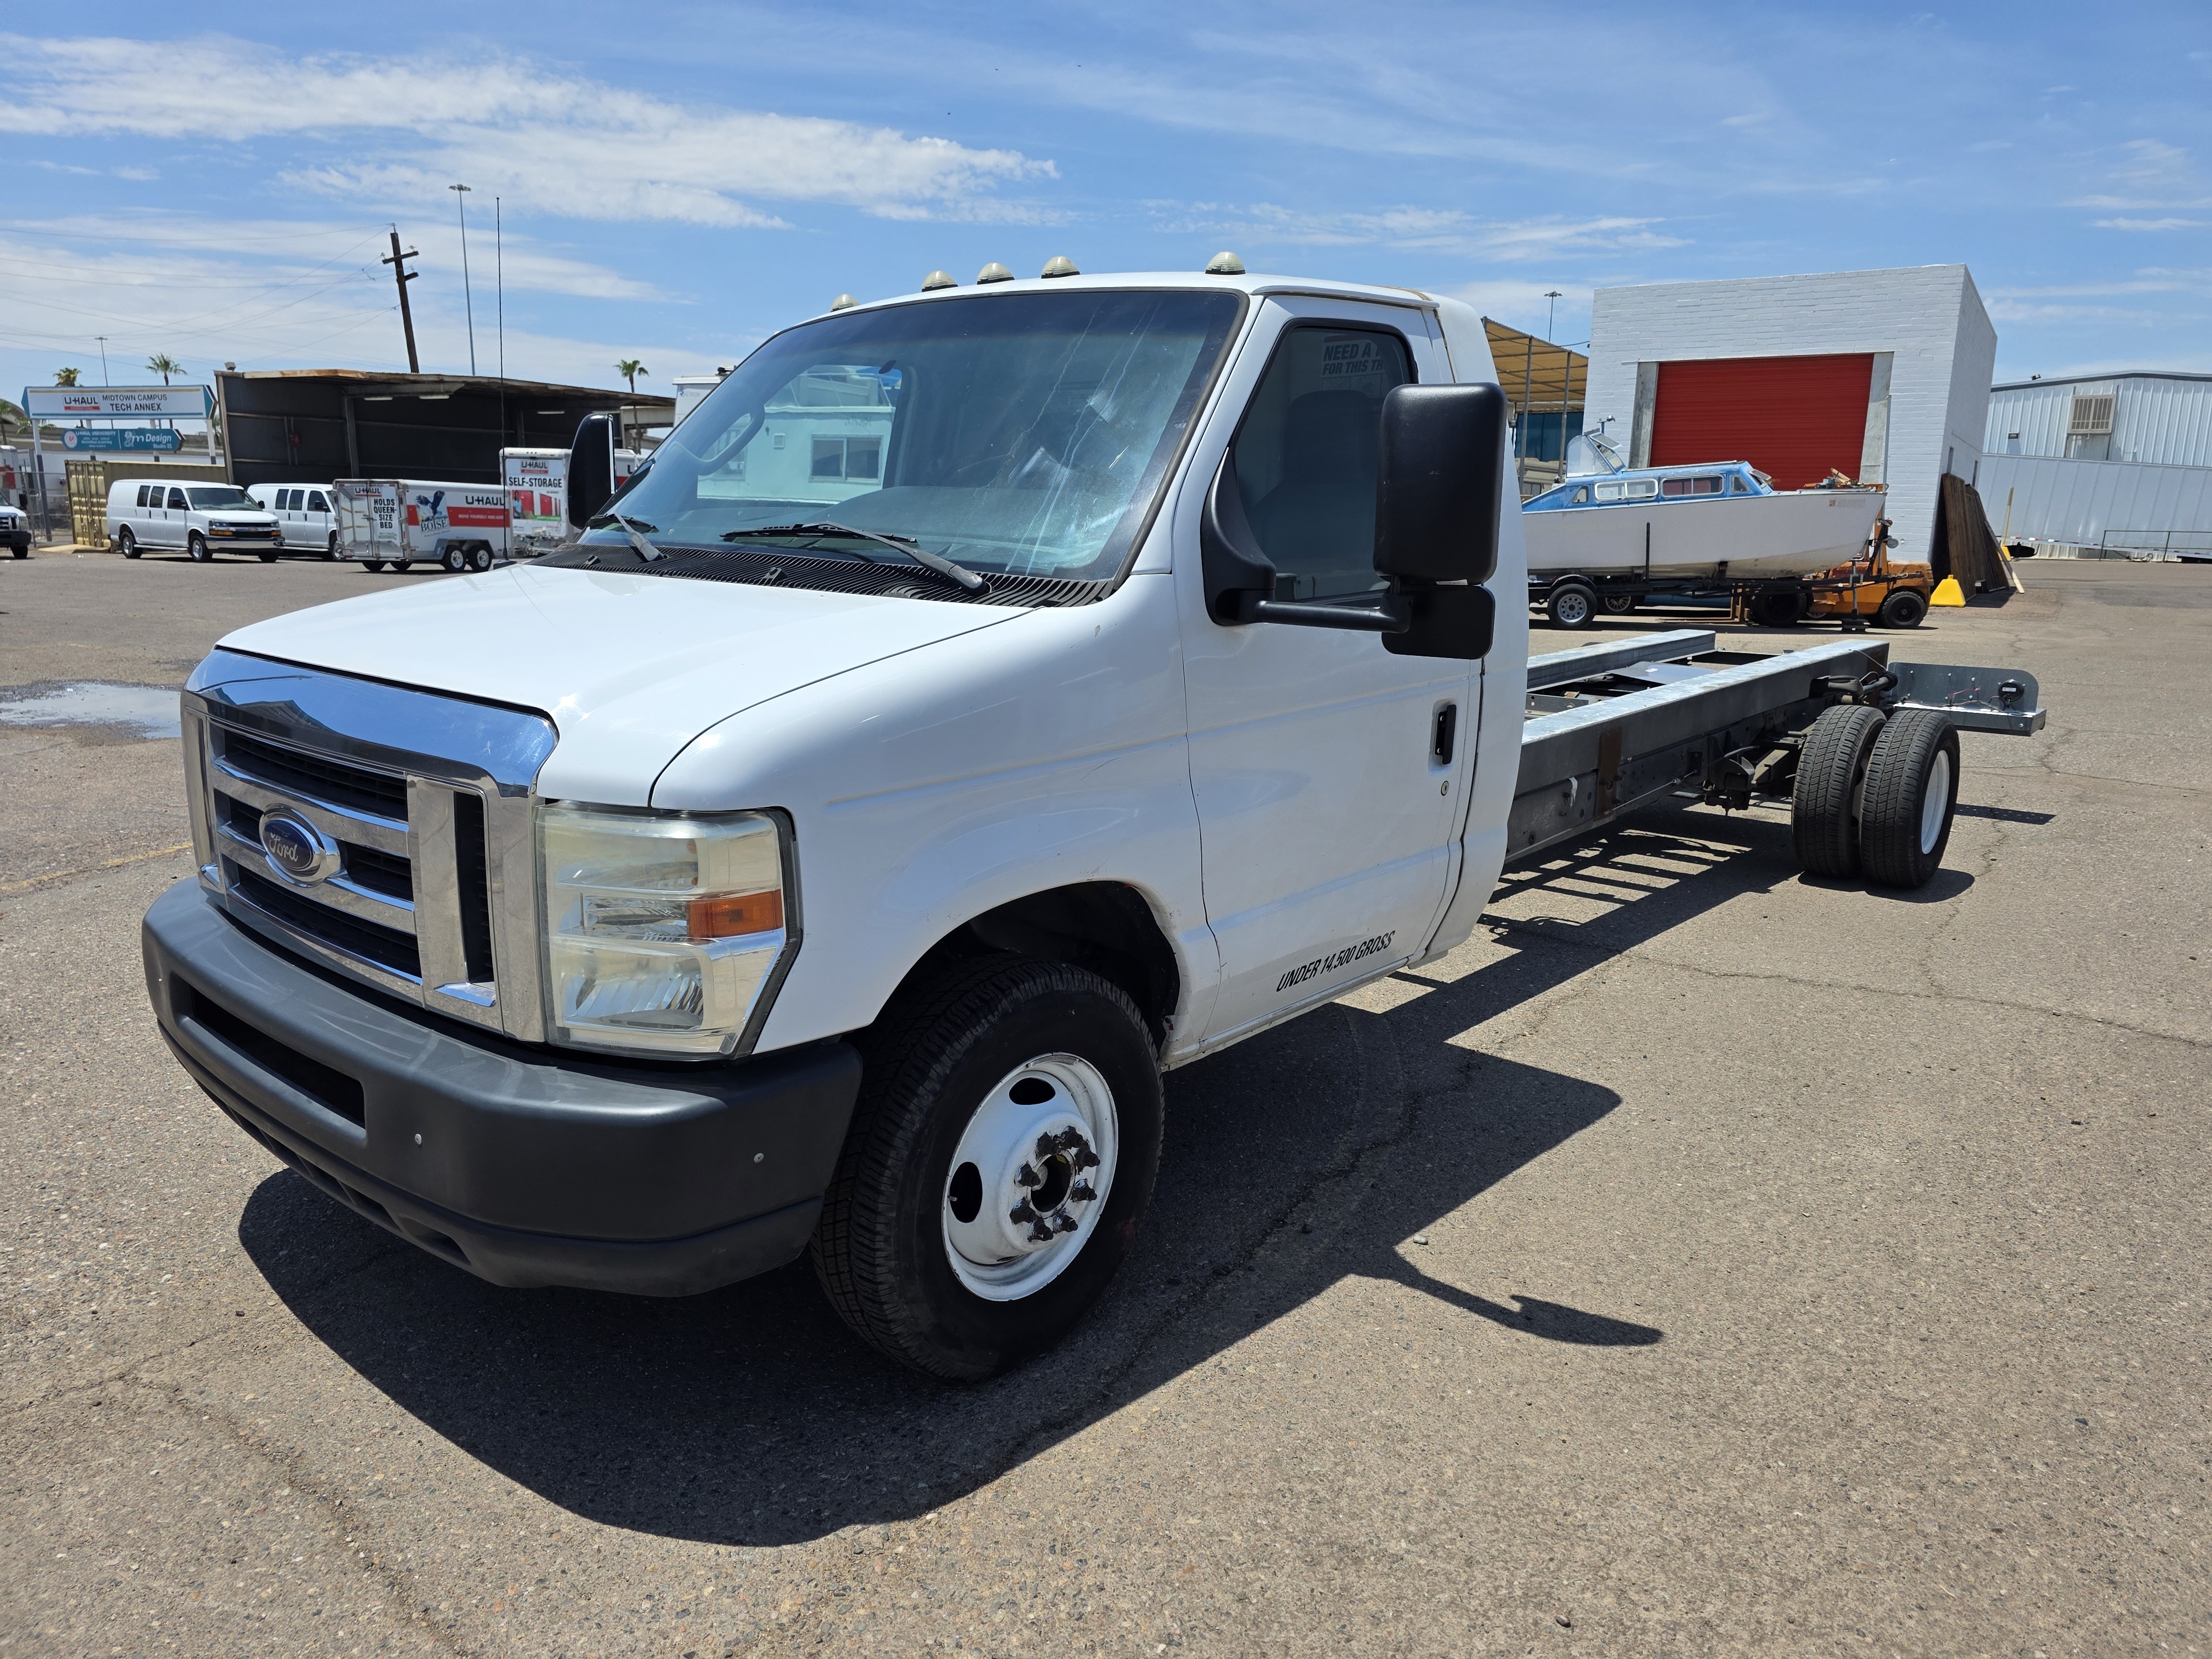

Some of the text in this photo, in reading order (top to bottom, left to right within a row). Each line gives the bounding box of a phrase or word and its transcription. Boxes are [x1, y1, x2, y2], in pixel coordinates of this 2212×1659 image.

[1323, 344, 1359, 362] NEED
[1361, 343, 1371, 358] A
[1323, 362, 1343, 375] FOR
[1345, 359, 1369, 373] THIS
[64, 397, 98, 405] U-HAUL
[110, 403, 162, 411] TECH ANNEX
[509, 477, 562, 488] SELF-STORAGE
[421, 518, 447, 532] BOISE
[269, 832, 299, 862] Ford
[1276, 930, 1396, 992] UNDER 14,500 GROSS
